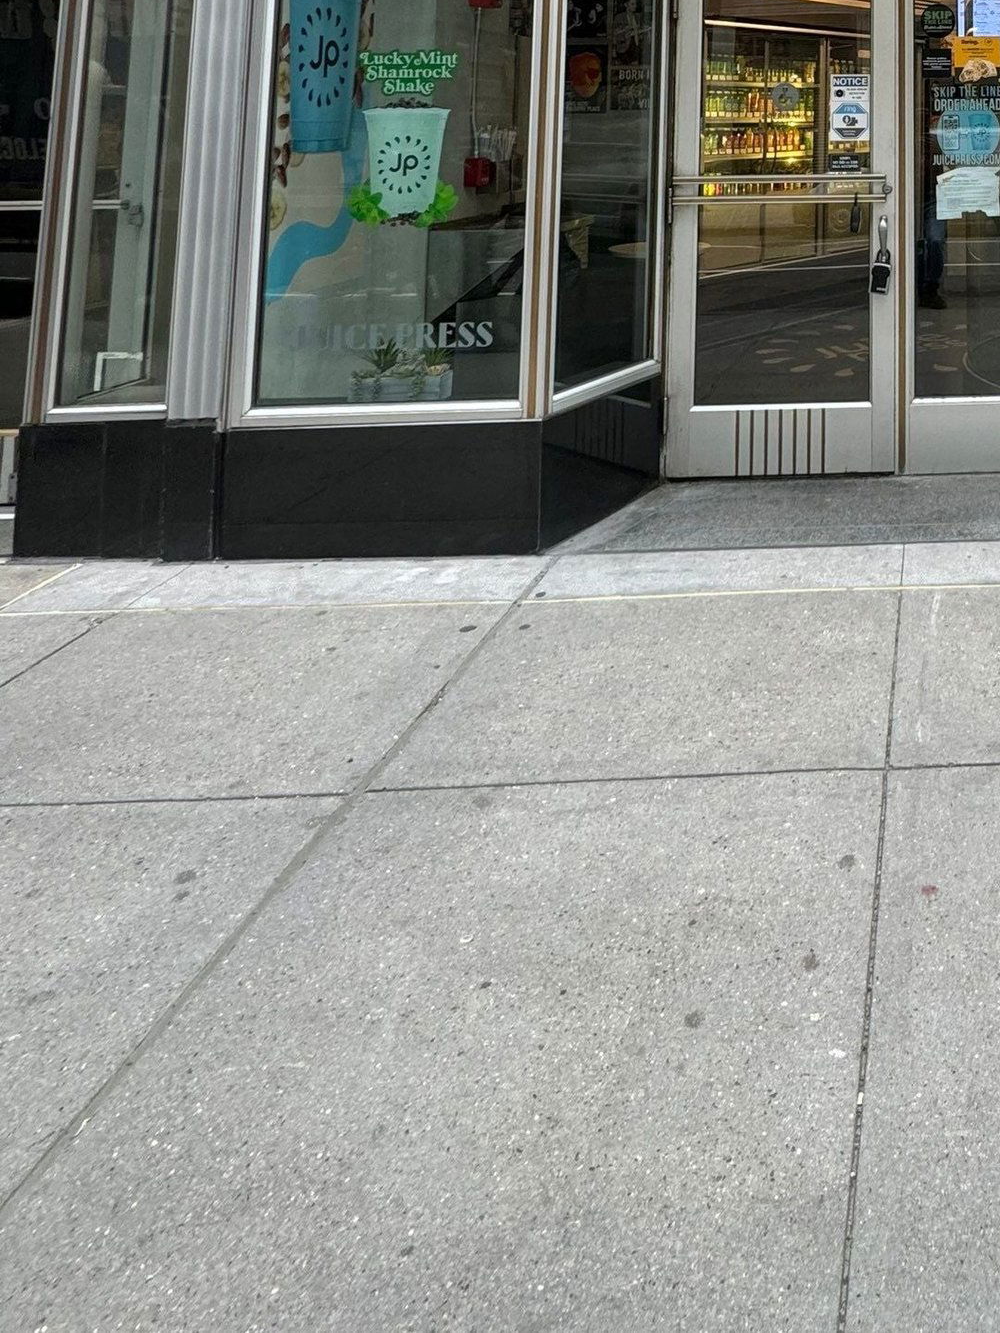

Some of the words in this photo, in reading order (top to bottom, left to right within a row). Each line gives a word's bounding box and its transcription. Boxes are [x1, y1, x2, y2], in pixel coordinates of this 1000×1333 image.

[923, 10, 952, 21] SKIP
[359, 51, 415, 69] Lucky
[413, 50, 458, 67] Mint
[366, 65, 453, 81] Shamrock
[383, 79, 435, 95] Shake
[833, 77, 869, 86] NOTICE
[934, 86, 956, 97] SKIP
[960, 86, 978, 97] THE
[934, 98, 967, 112] ORDER
[395, 320, 494, 350] PRESS
